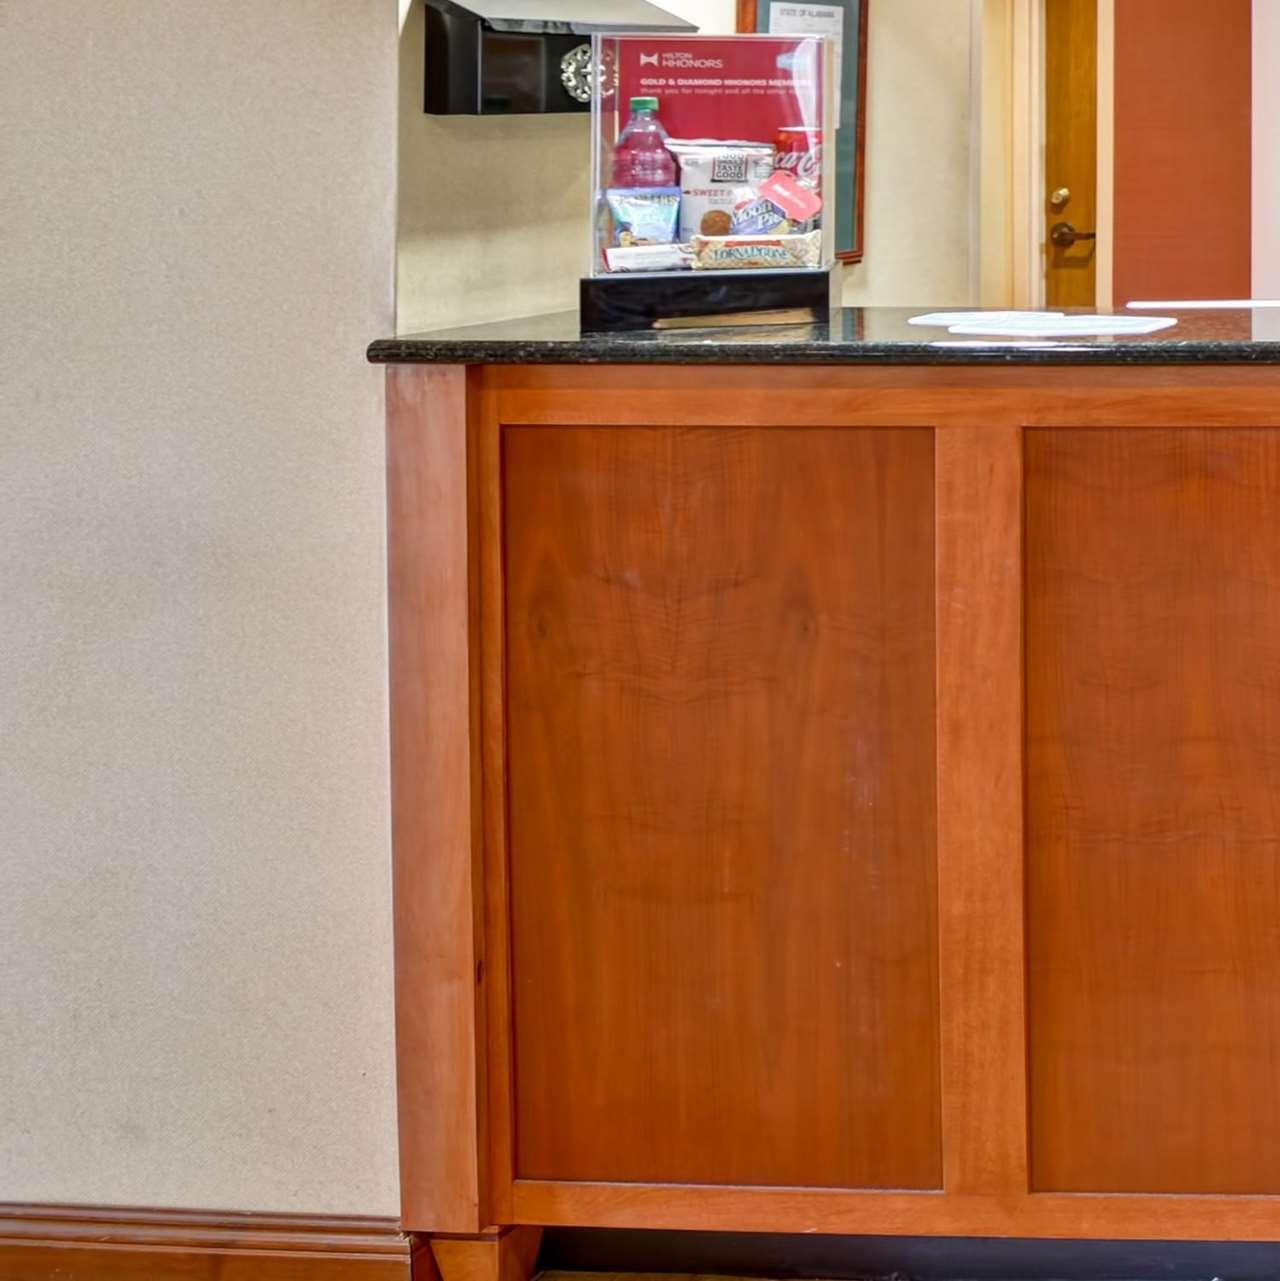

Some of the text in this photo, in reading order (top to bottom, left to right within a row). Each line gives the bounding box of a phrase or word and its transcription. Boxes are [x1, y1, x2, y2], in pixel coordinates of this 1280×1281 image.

[640, 78, 666, 86] GOLD
[668, 78, 676, 86] &
[677, 78, 722, 86] DIAMOND
